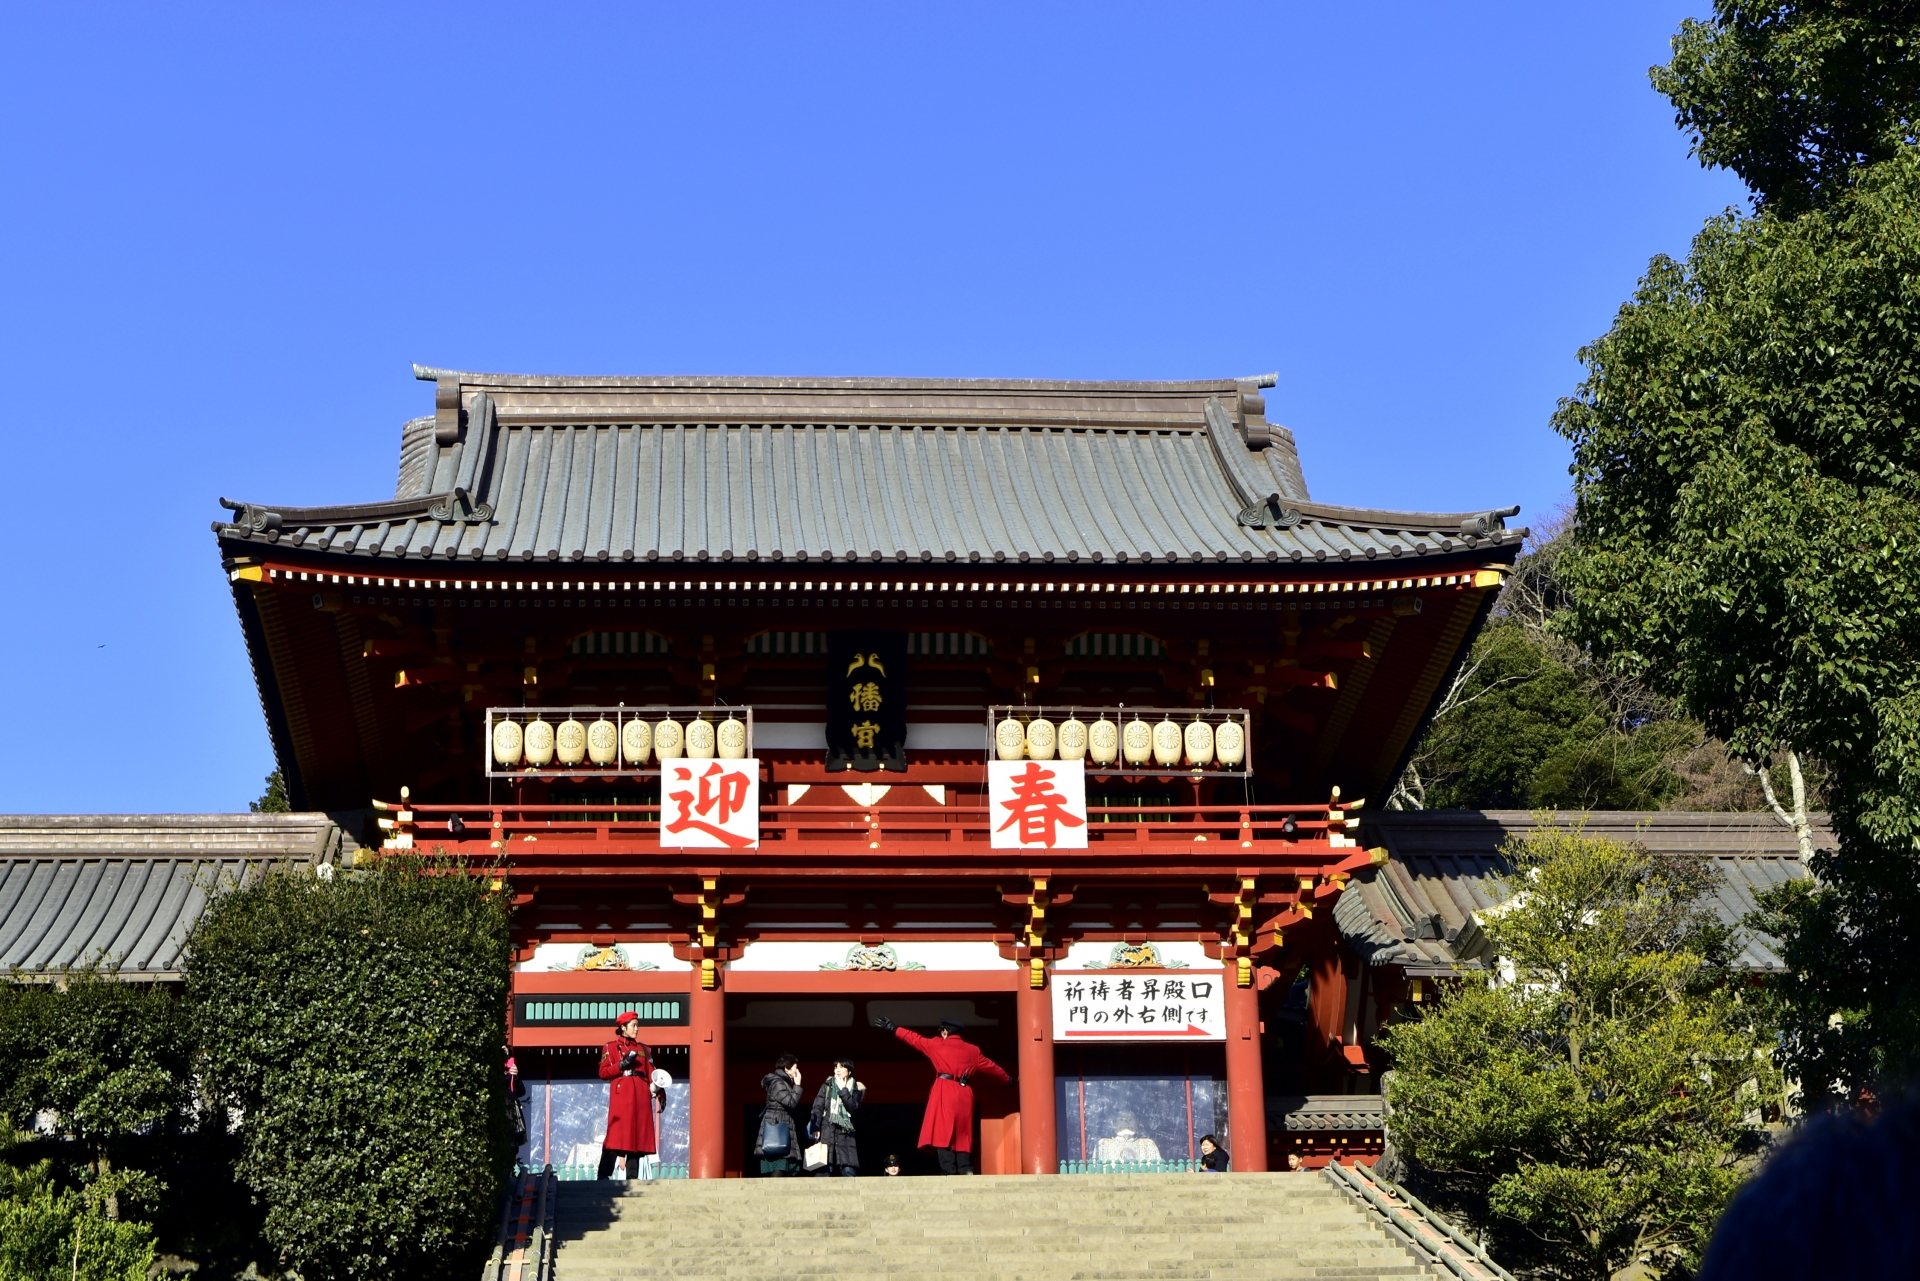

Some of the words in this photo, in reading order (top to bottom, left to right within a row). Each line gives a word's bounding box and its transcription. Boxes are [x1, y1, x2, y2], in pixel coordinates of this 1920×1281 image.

[846, 652, 887, 749] 八幡宮
[664, 761, 757, 848] 迎
[995, 761, 1086, 848] 春
